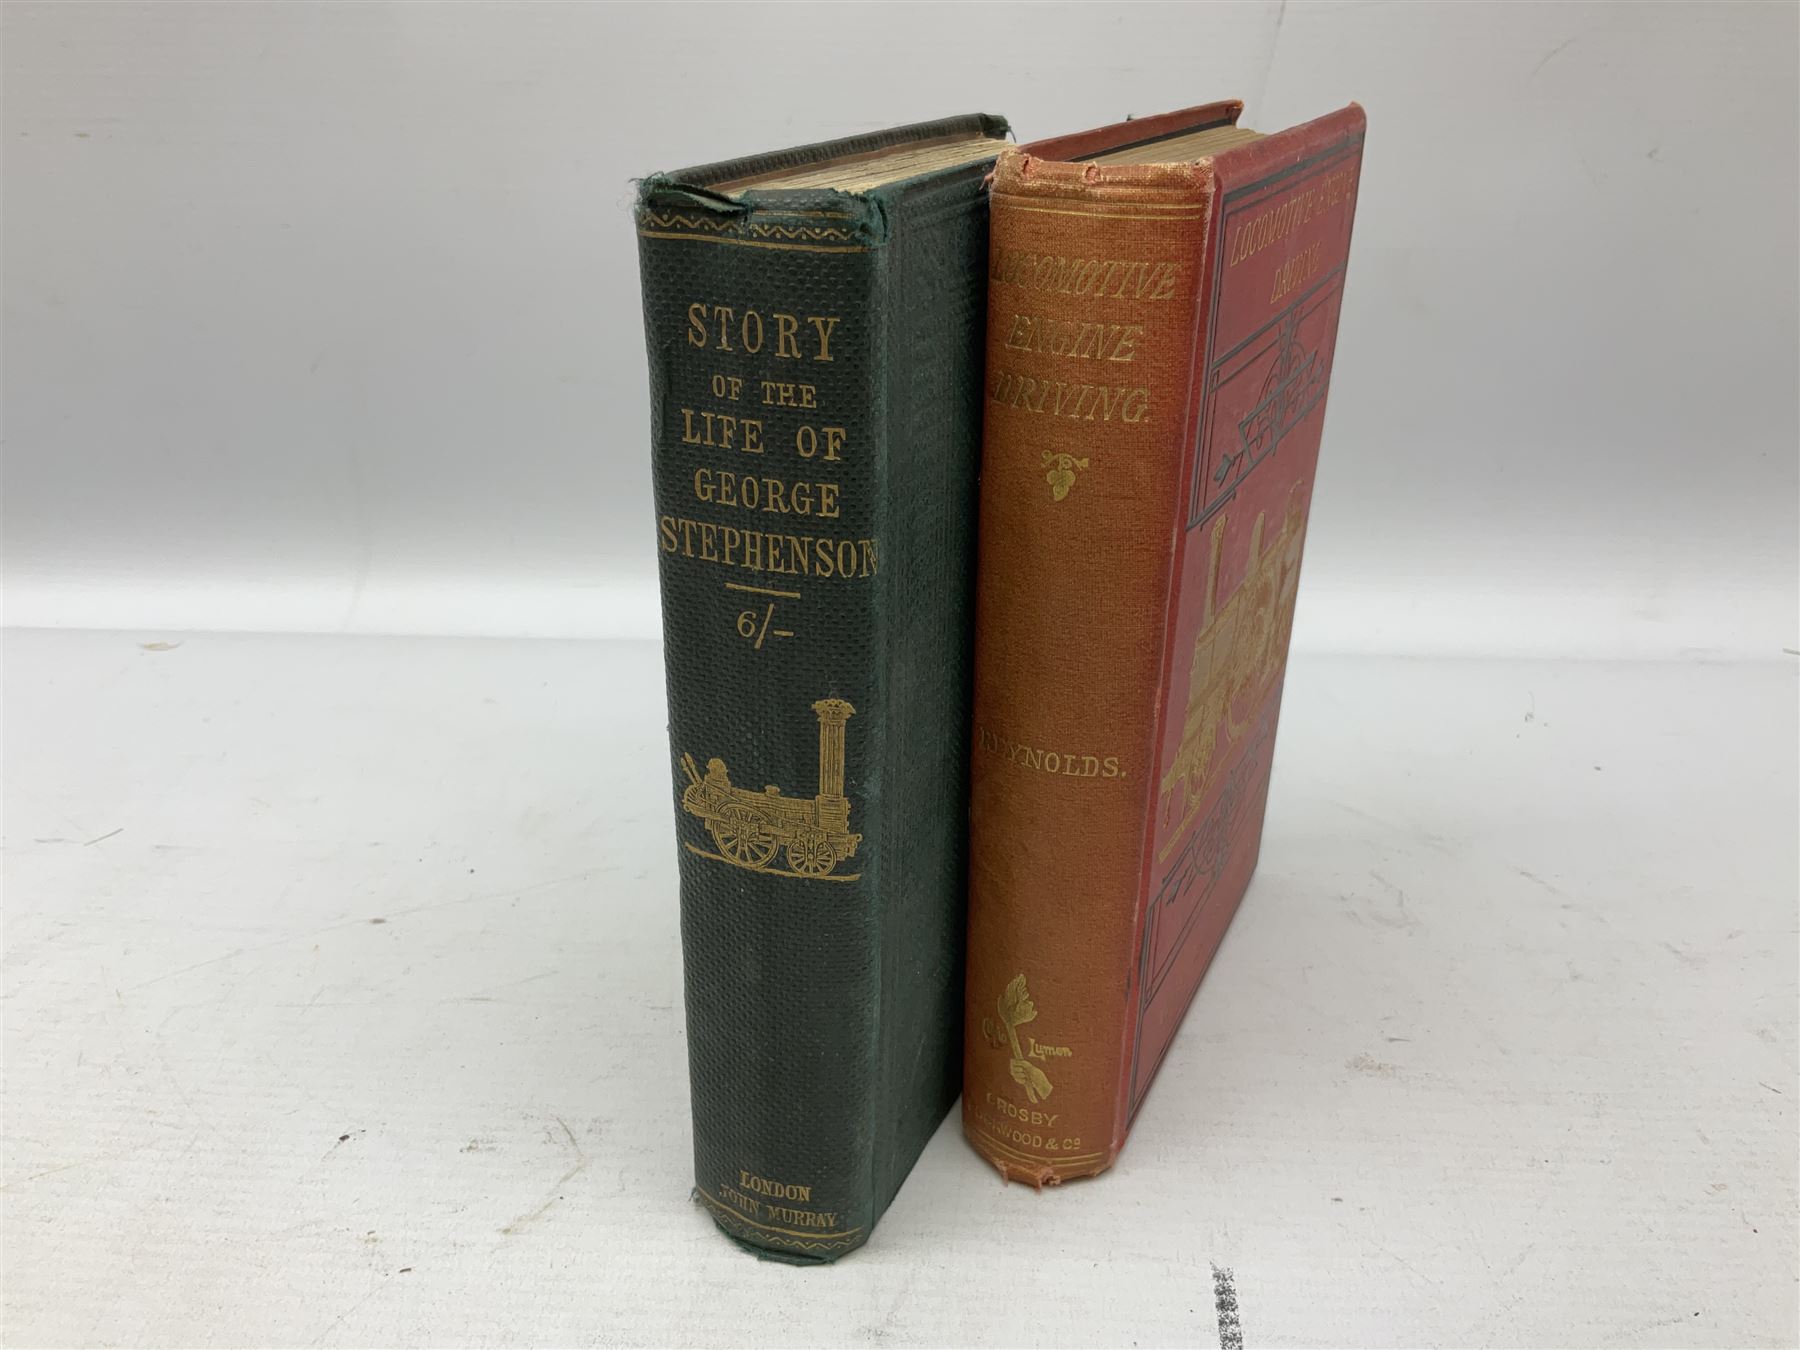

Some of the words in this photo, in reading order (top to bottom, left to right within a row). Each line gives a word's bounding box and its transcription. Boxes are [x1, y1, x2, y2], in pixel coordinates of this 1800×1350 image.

[688, 303, 840, 361] STORY
[1005, 314, 1143, 361] ENGINE
[712, 375, 742, 400] OF
[761, 381, 817, 409] THE
[681, 408, 764, 453] LIFE
[796, 426, 846, 460] OF
[694, 468, 840, 518] GEORGE
[659, 516, 880, 578] STEPHENSON
[1045, 1137, 1059, 1150] &
[719, 1184, 761, 1215] JOHN
[766, 1205, 837, 1227] MURRAY
[740, 1170, 811, 1201] LONDON
